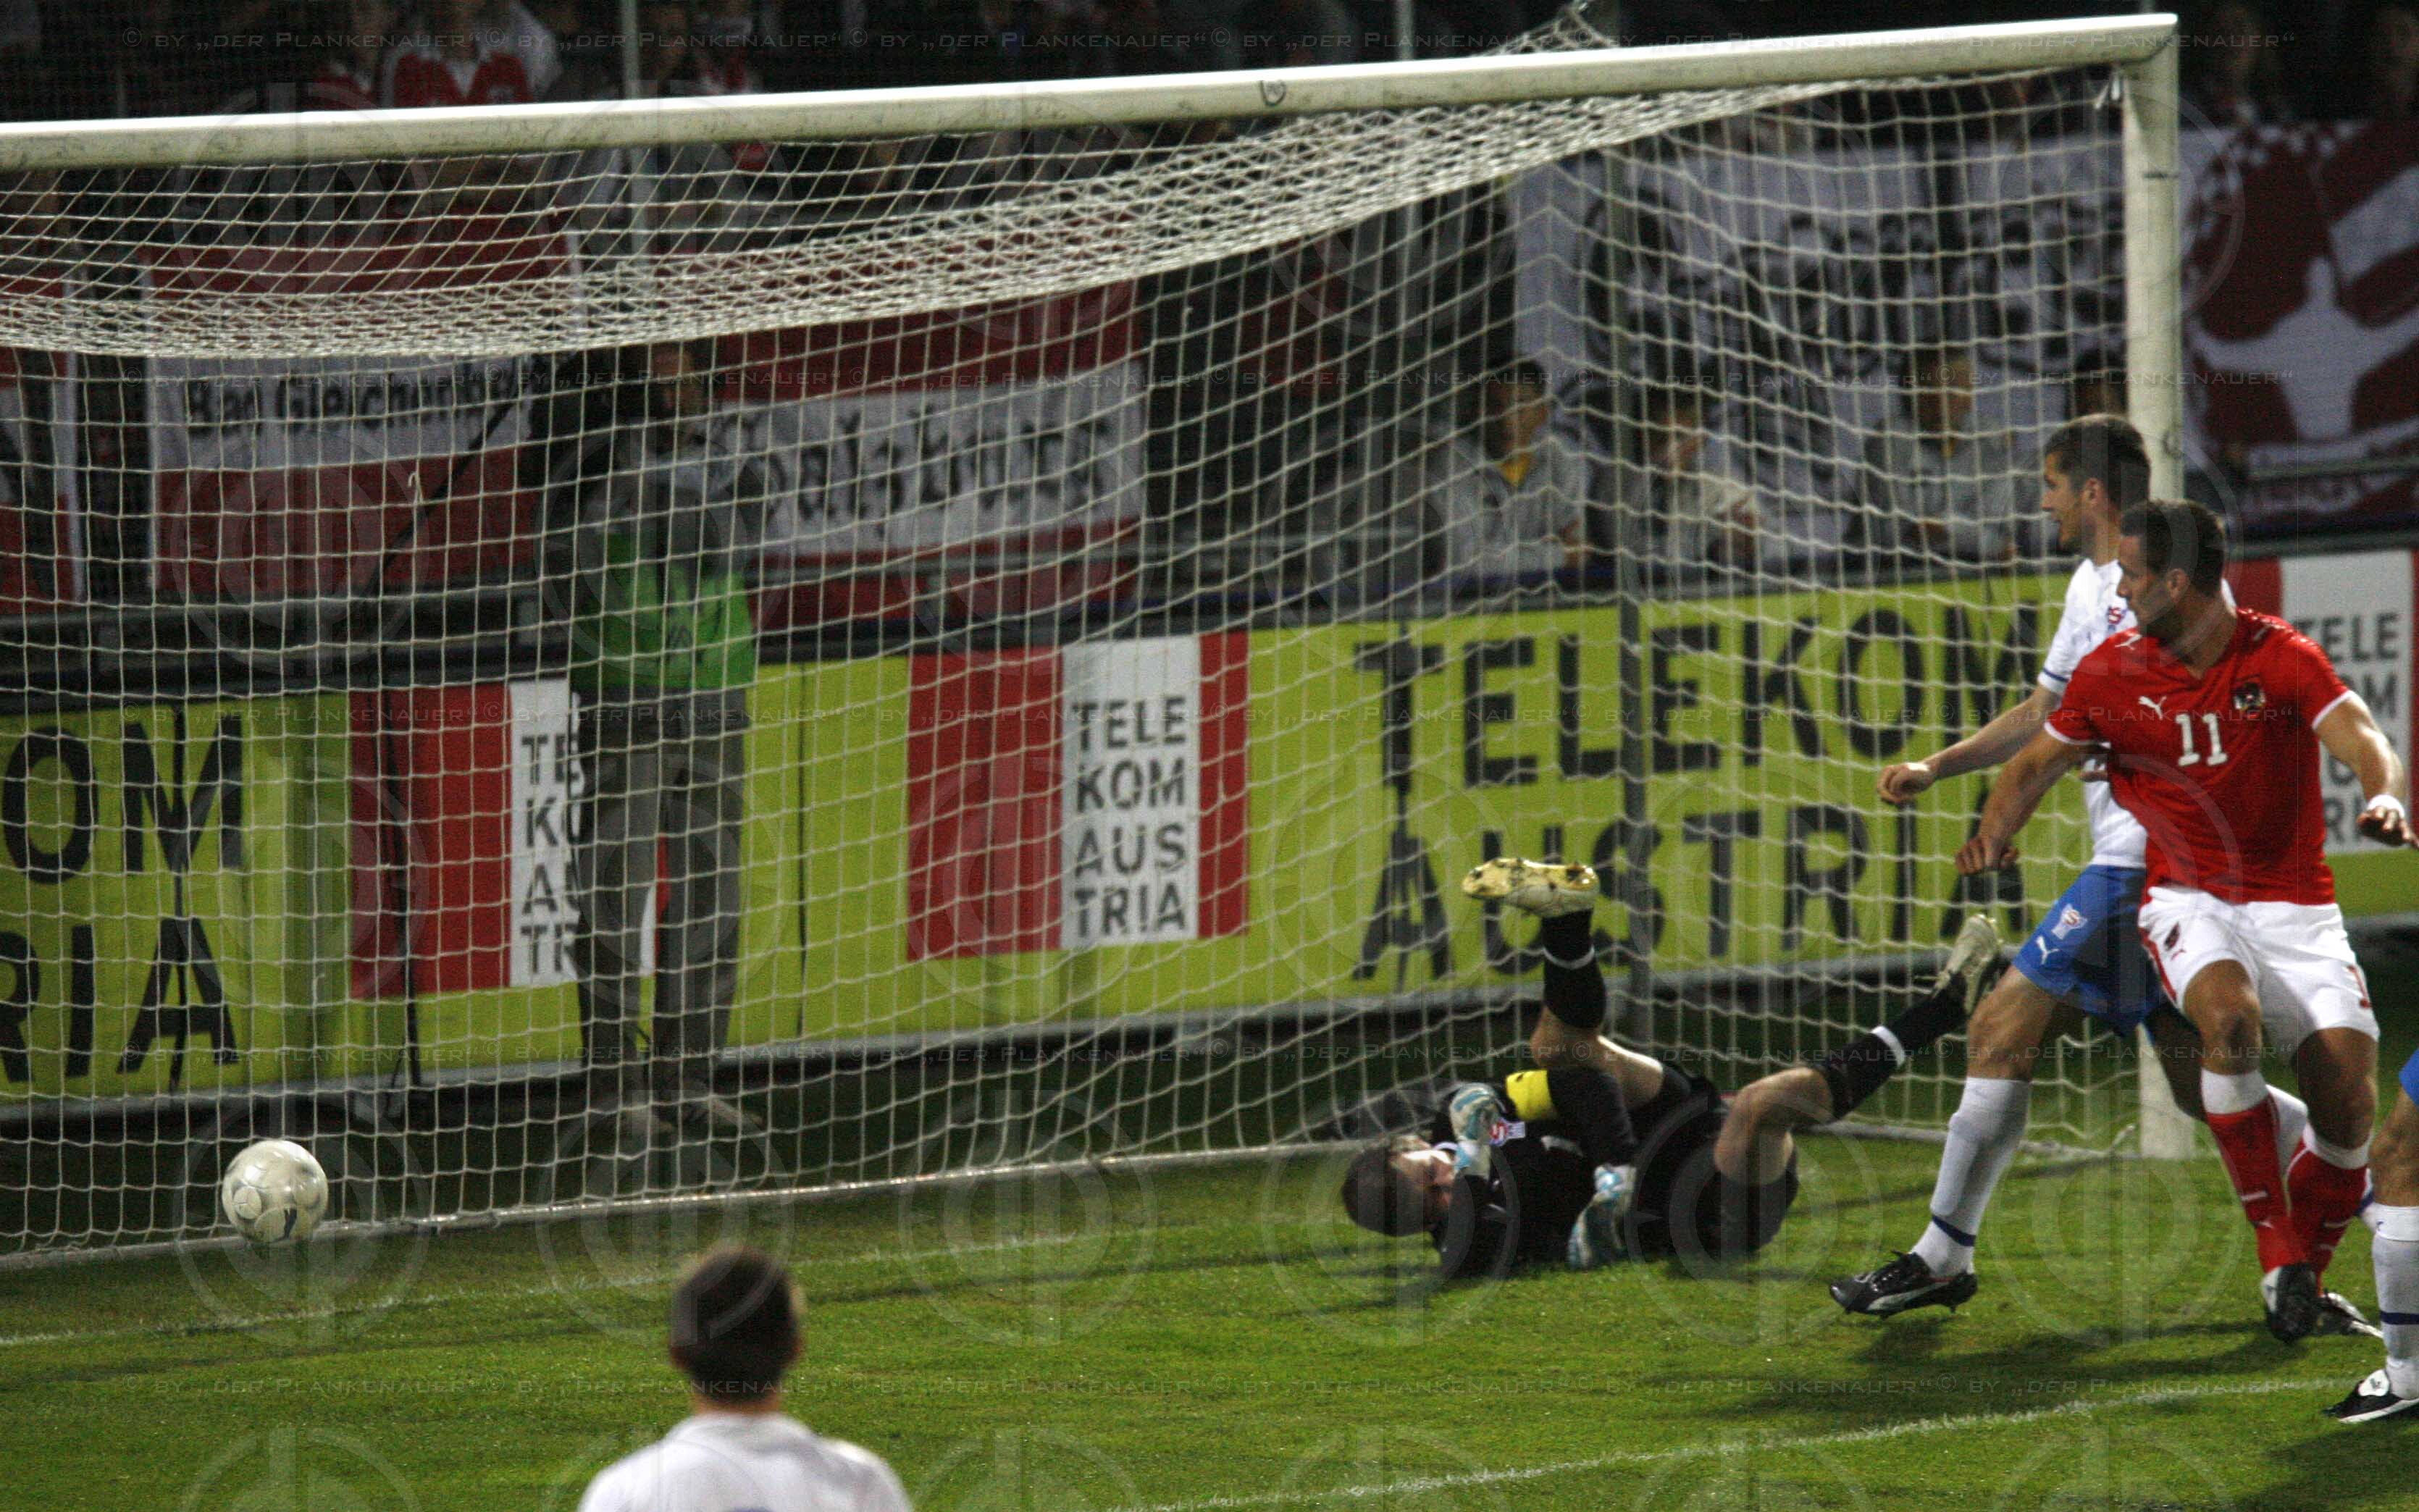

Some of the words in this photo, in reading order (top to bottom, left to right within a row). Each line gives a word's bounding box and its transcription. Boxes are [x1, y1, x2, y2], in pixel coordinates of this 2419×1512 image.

[1072, 695, 1186, 751] TELE
[1352, 599, 2039, 791] TELEKOM
[2175, 713, 2228, 767] 11
[2, 713, 244, 885] OM
[1076, 757, 1186, 814] KOM
[1075, 821, 1186, 877] AUS
[1073, 882, 1186, 938] TRIA
[1352, 791, 2026, 981] AUSTRIA
